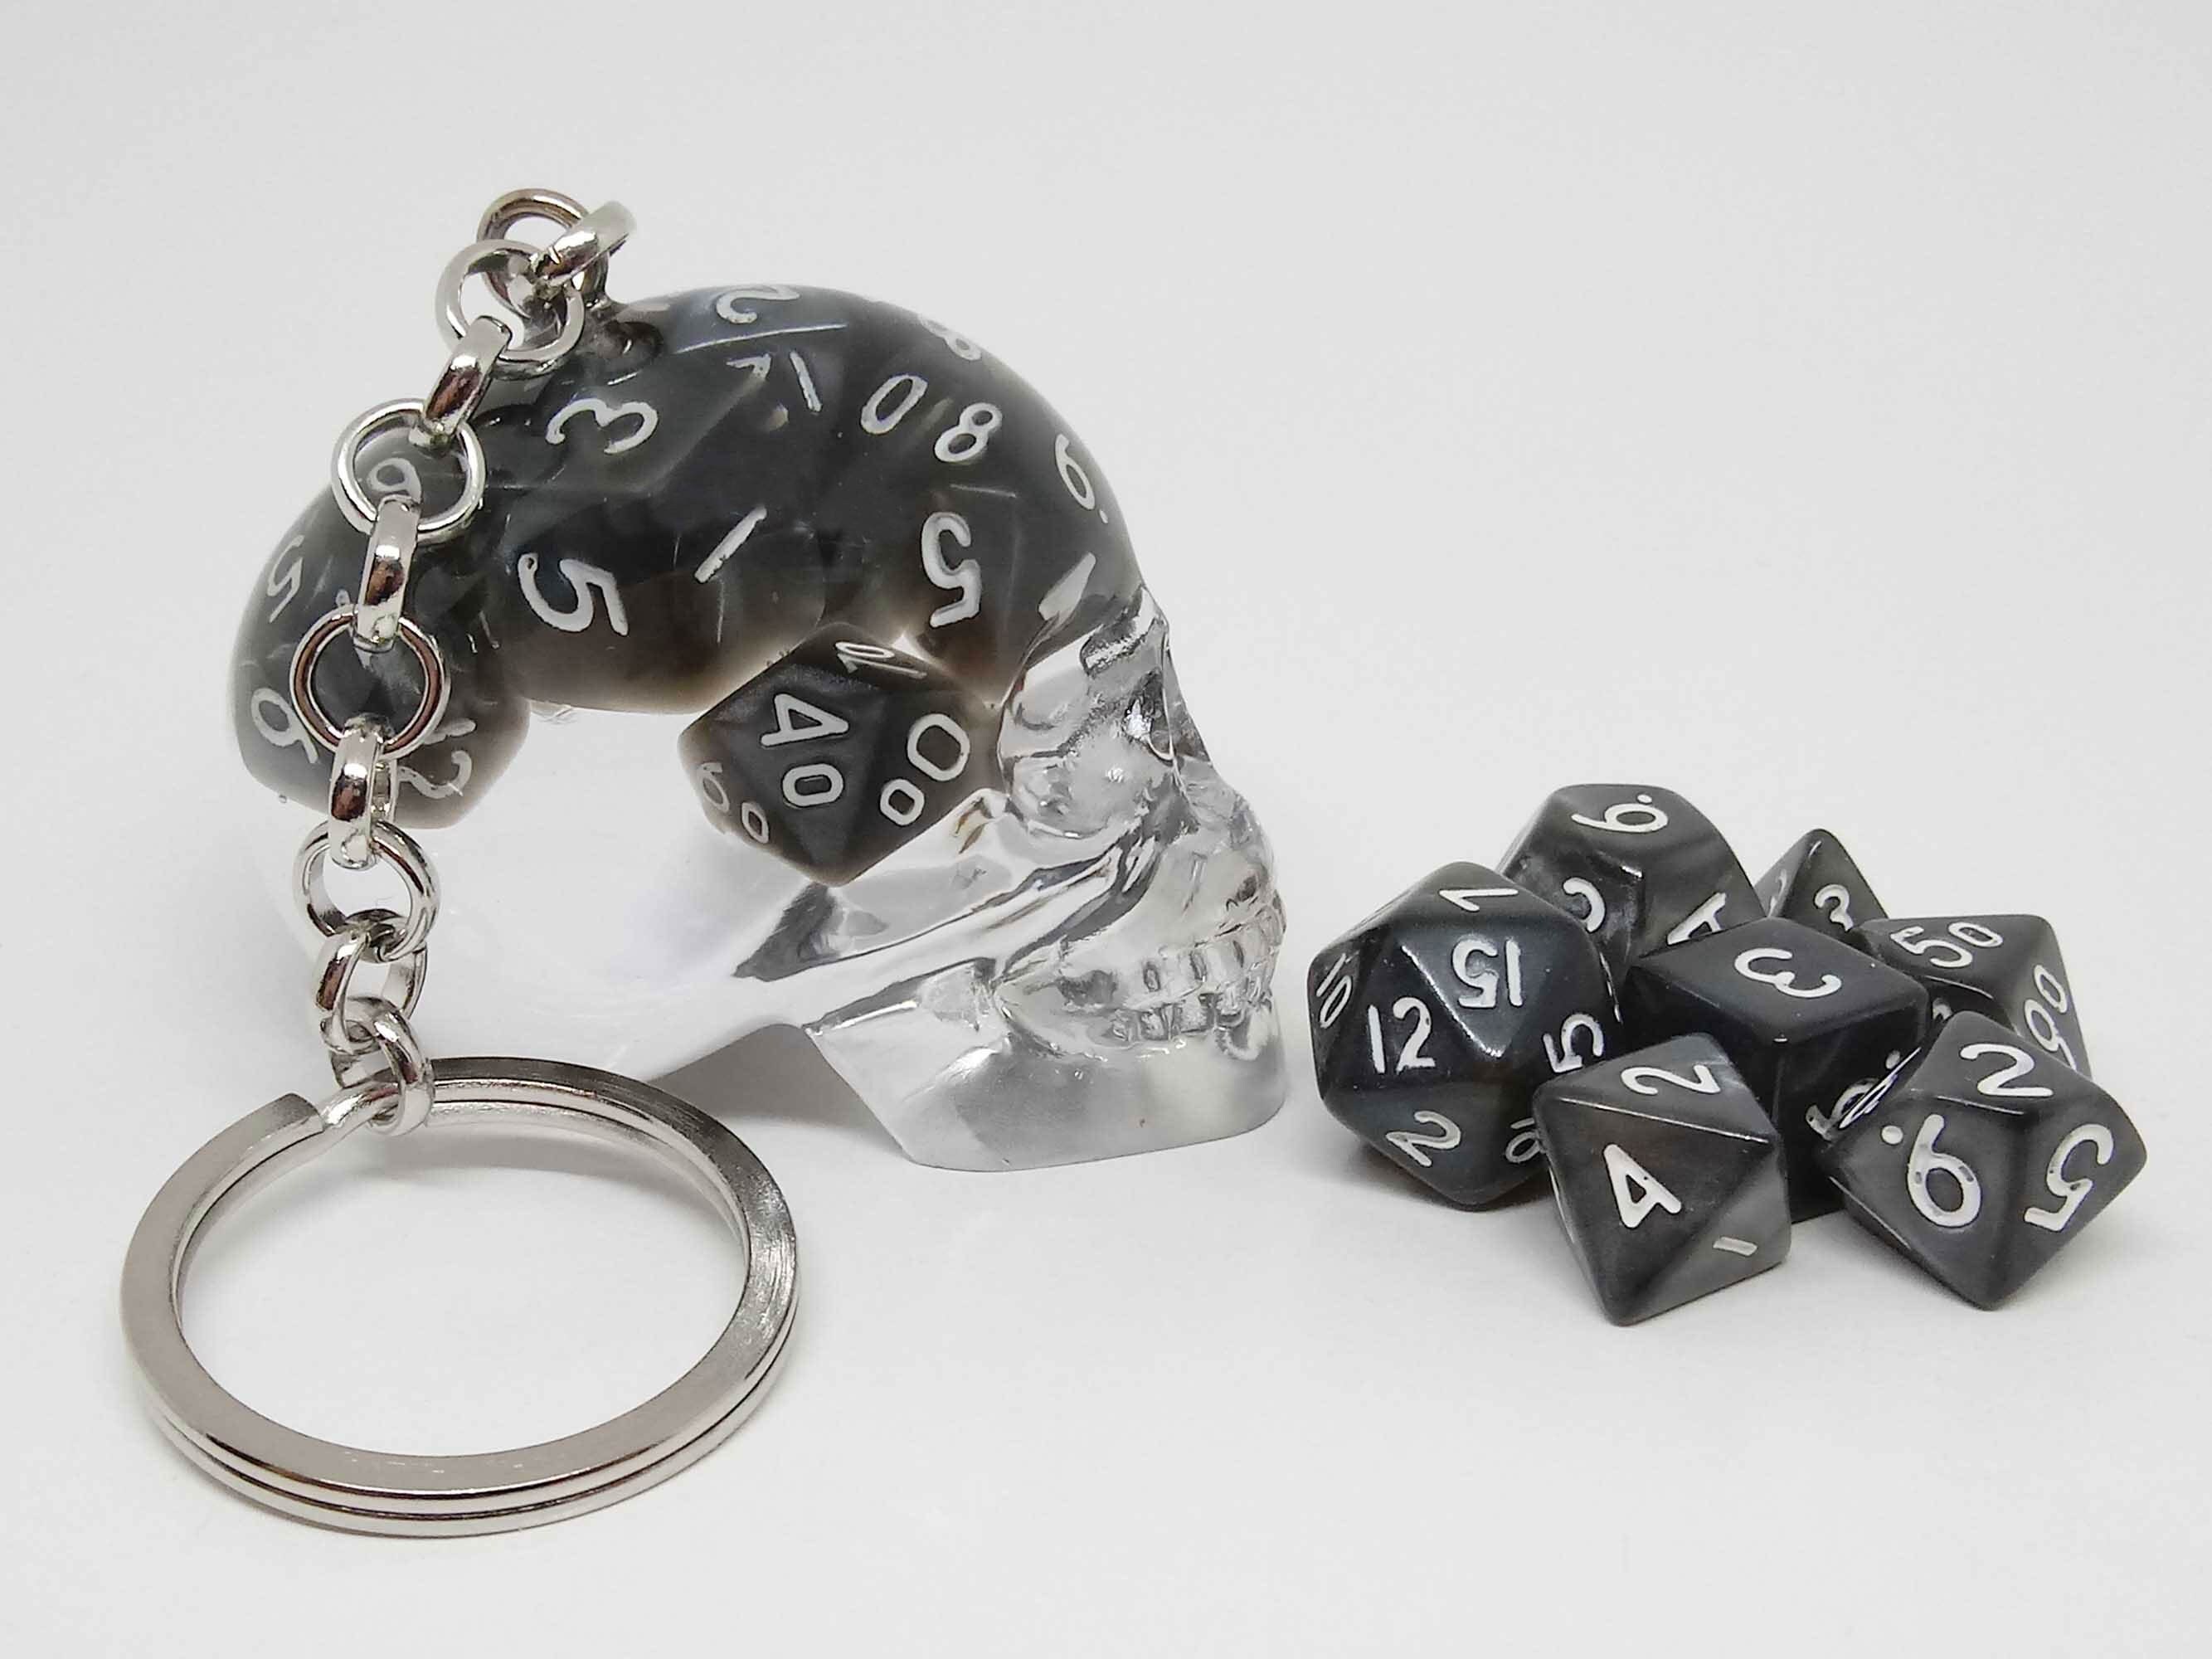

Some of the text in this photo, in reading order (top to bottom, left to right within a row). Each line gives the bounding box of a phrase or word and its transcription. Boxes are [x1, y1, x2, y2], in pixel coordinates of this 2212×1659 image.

[546, 398, 659, 454] 3
[934, 402, 1003, 463] 8
[517, 552, 630, 637] 5
[921, 511, 982, 630] 5
[1451, 933, 1524, 1010] 15
[1733, 947, 1843, 999] 3
[1889, 920, 2004, 969] 50
[1368, 996, 1437, 1075] 12
[1543, 1013, 1605, 1073] 5
[1620, 1064, 1722, 1096] 2
[1959, 1043, 2054, 1097] 2
[1385, 1111, 1462, 1168] 2
[1602, 1143, 1683, 1228] 4
[2023, 1122, 2116, 1233] 5
